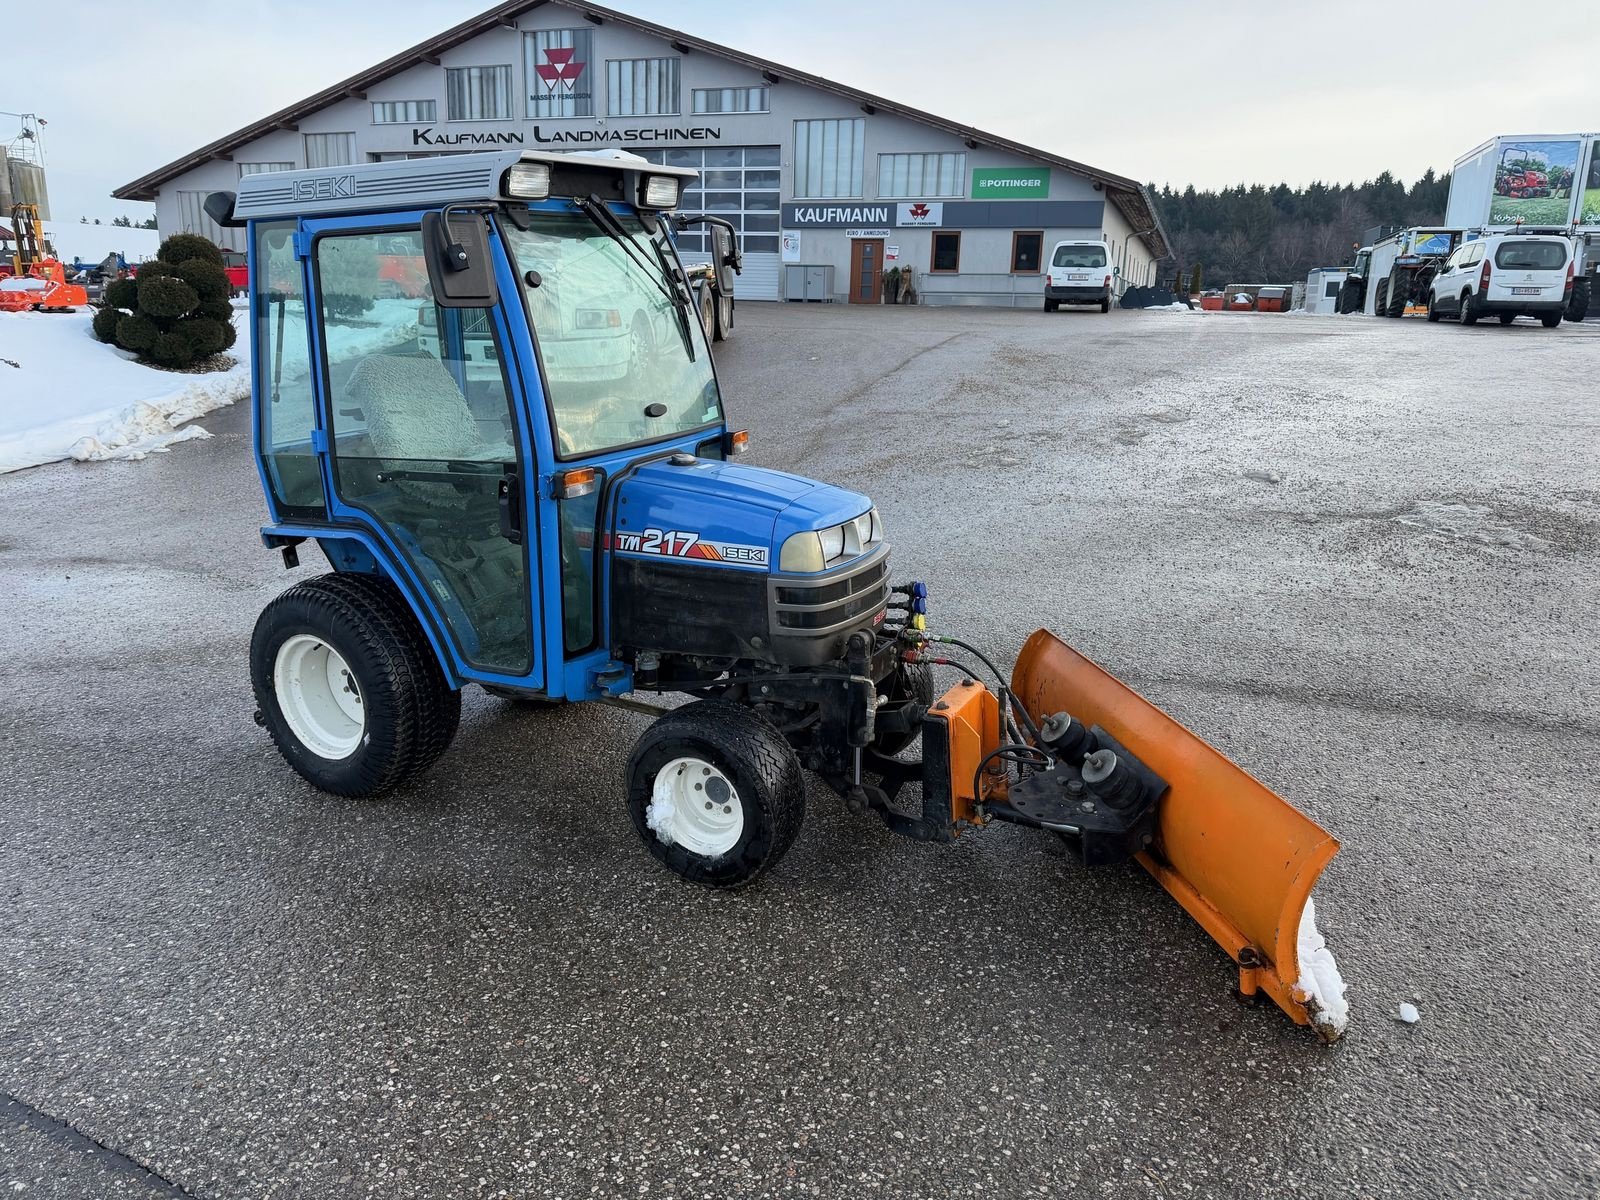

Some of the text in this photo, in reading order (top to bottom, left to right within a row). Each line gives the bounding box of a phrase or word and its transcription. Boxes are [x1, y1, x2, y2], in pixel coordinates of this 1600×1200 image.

[413, 126, 721, 145] KAUFMANN LANDMASCHINEN
[292, 175, 356, 201] ISEKI
[794, 207, 888, 223] KAUFMANN
[721, 546, 766, 562] ISEKI
